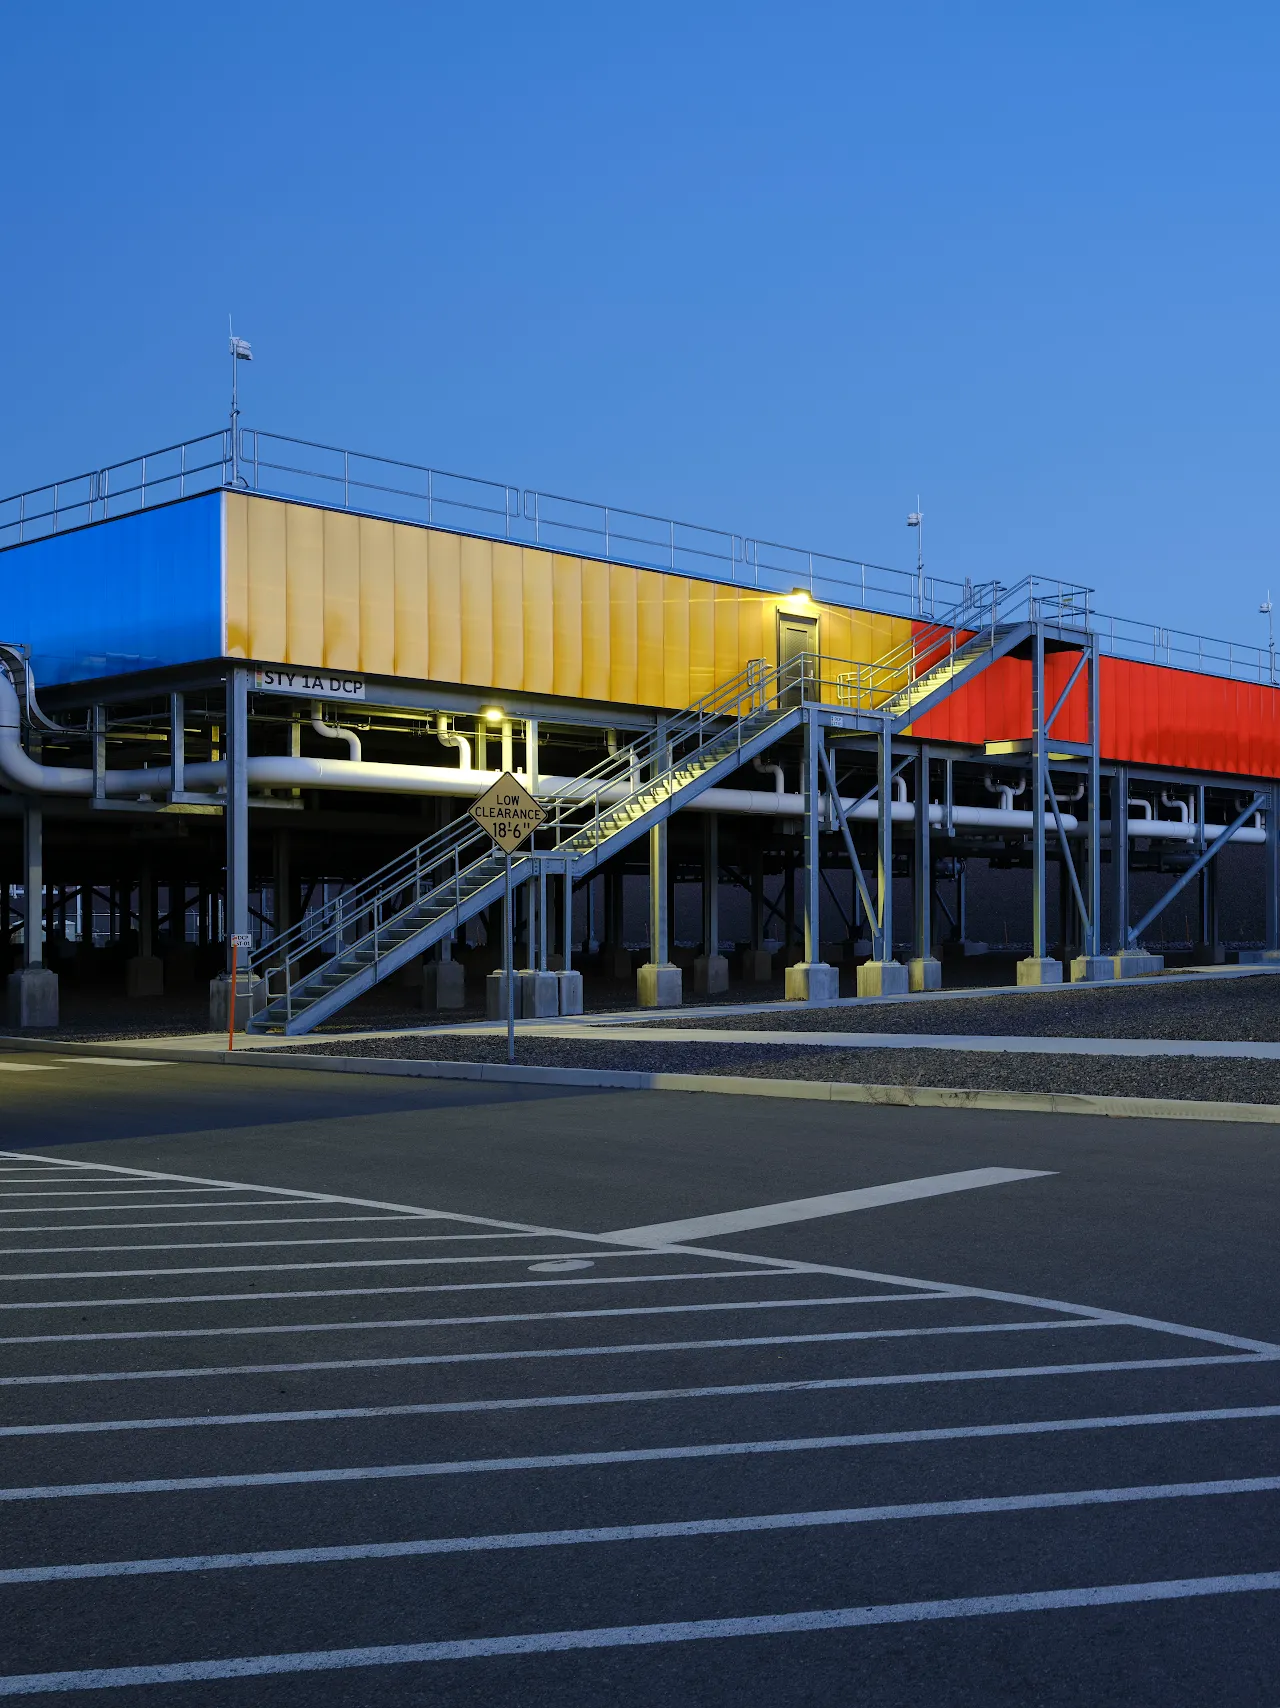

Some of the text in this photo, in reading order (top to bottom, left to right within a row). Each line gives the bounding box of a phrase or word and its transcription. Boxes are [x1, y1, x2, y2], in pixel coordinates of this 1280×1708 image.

[264, 670, 363, 694] STY 1A DCP
[496, 794, 519, 806] LOW
[475, 806, 541, 820] CLEARANCE
